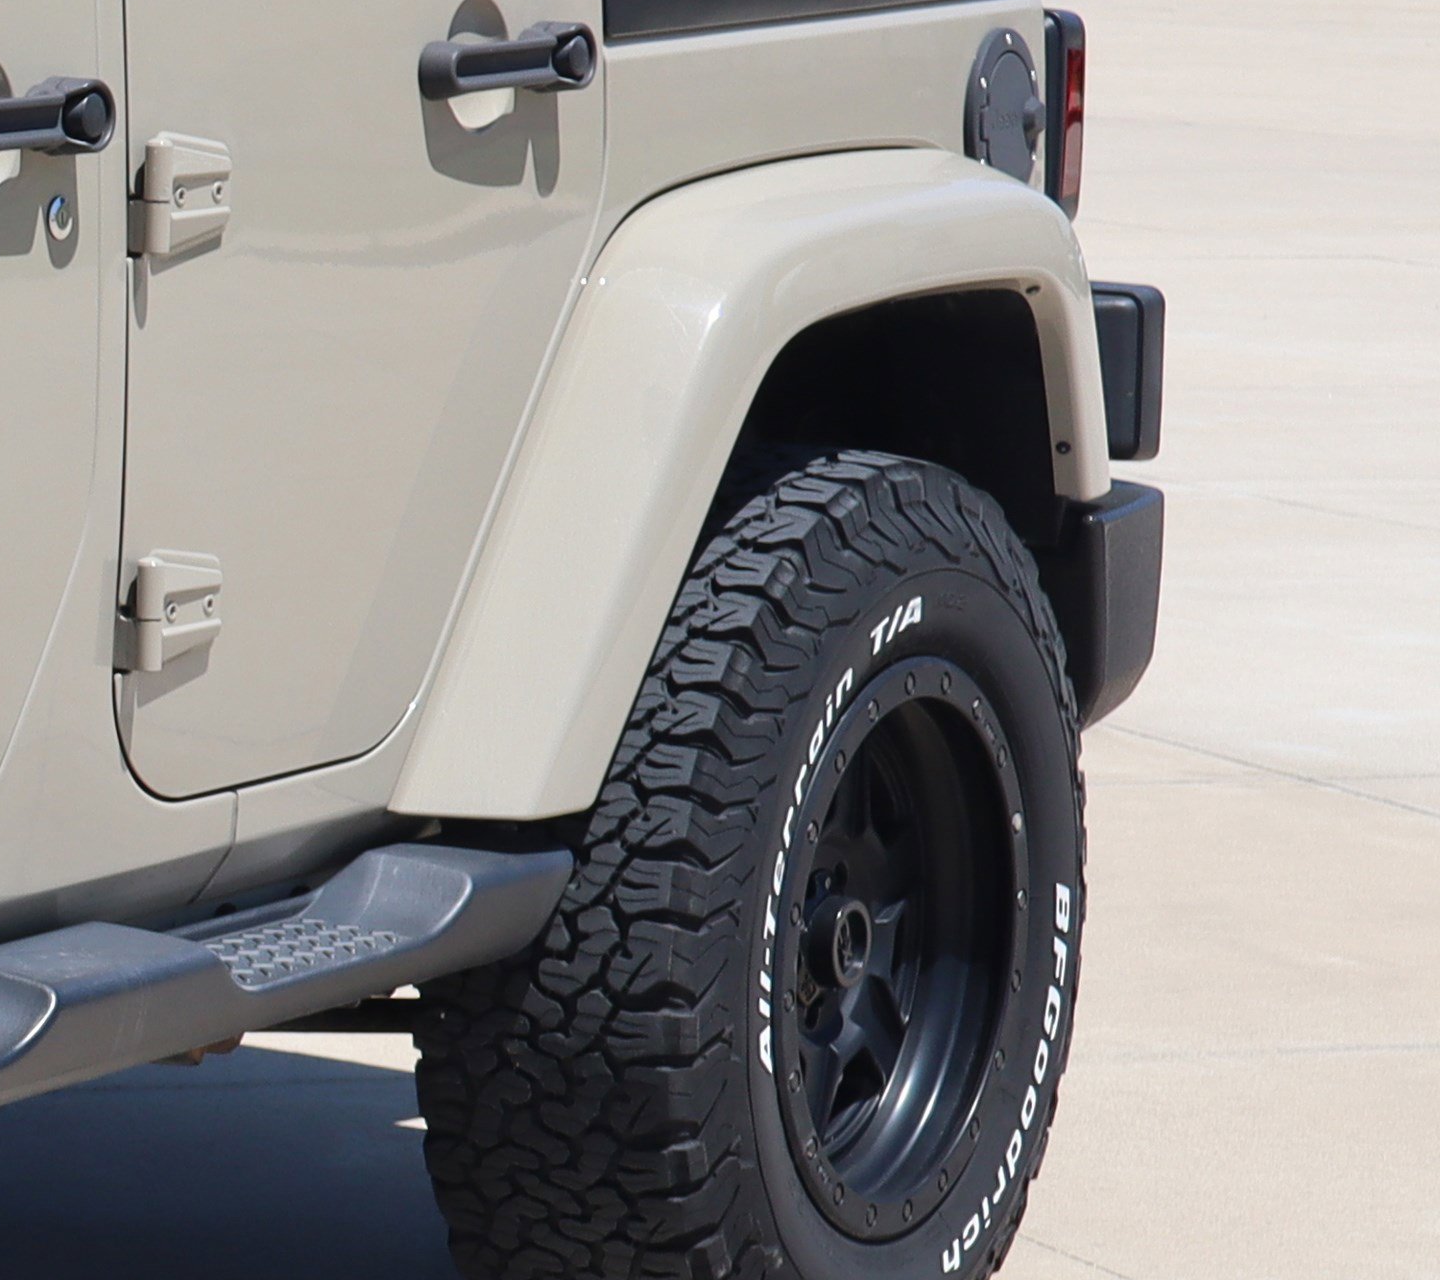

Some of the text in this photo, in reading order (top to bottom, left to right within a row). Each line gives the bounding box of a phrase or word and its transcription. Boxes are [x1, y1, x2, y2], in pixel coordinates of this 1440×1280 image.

[758, 594, 924, 1075] All-Terrain T/A
[940, 882, 1072, 1276] BFGoodrich
